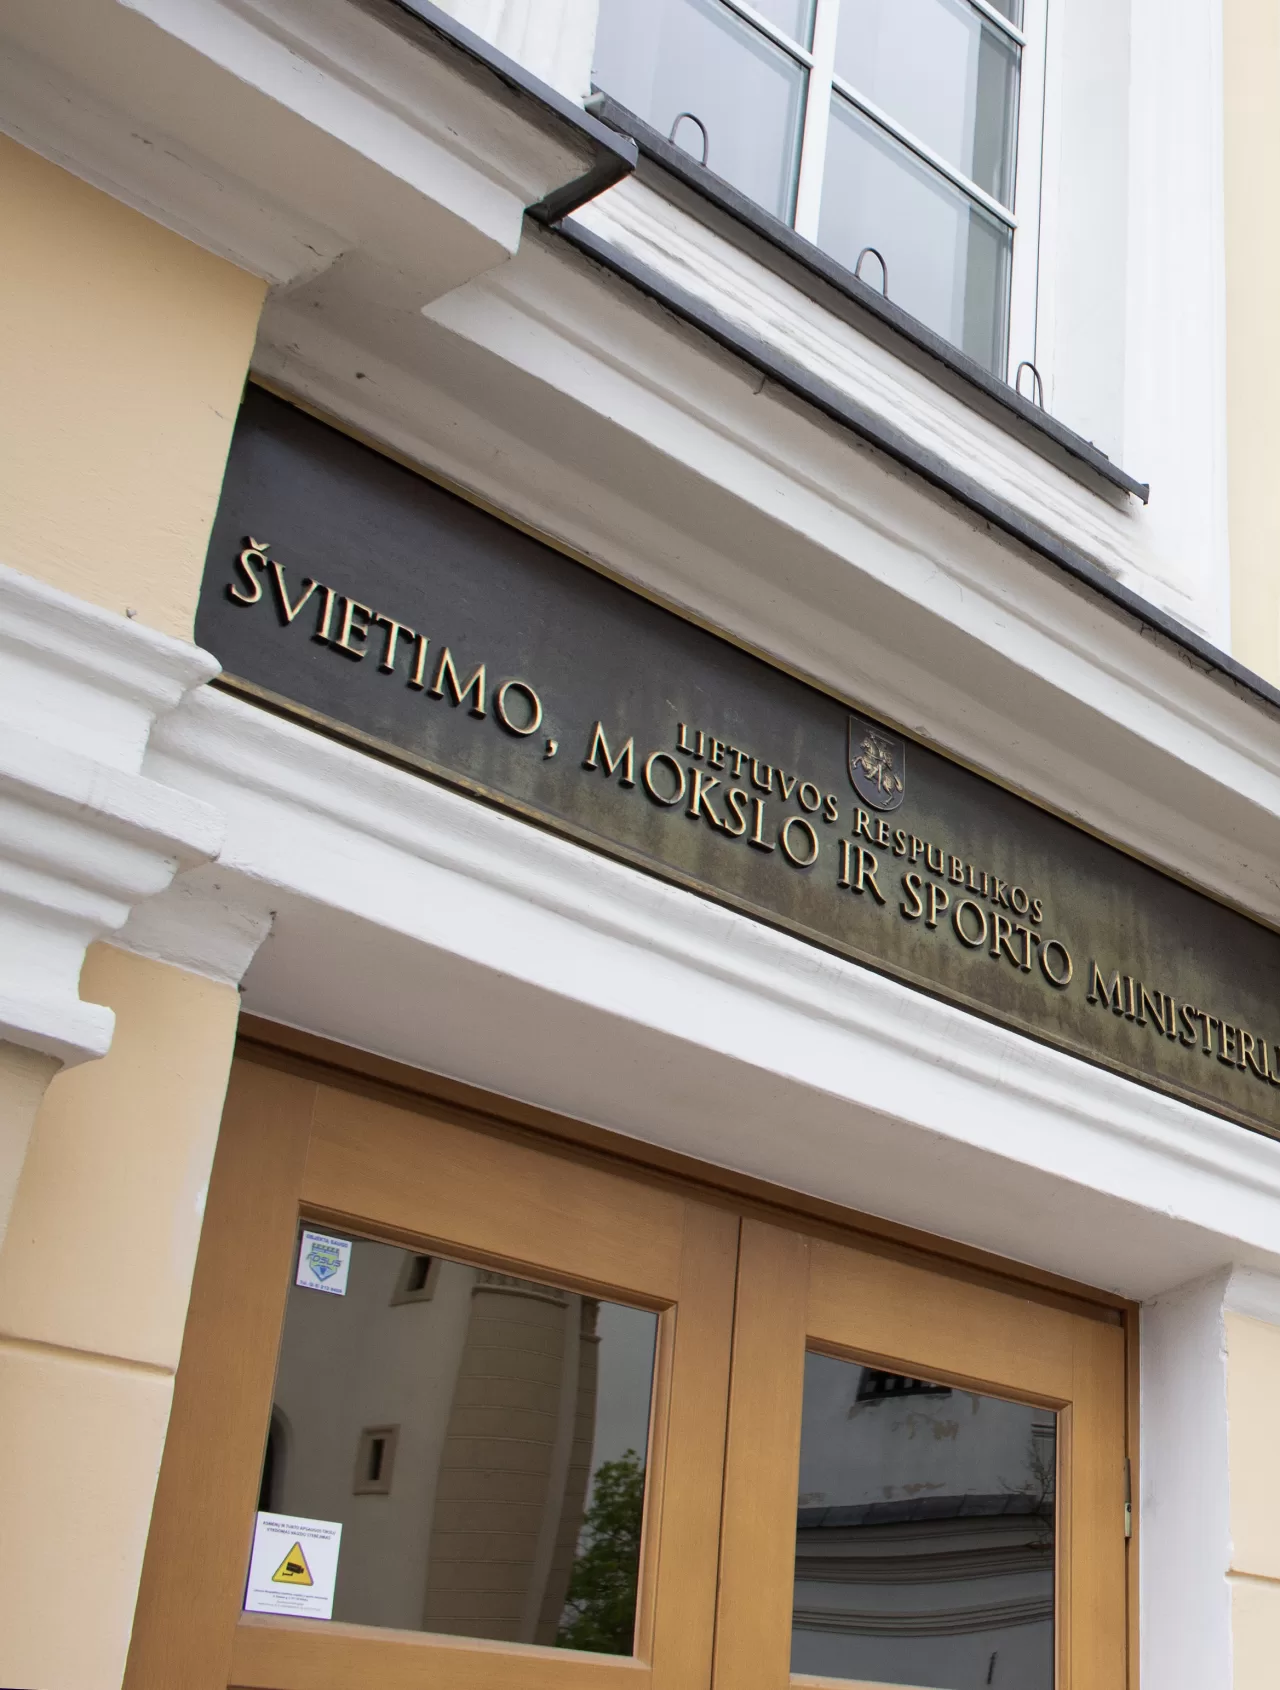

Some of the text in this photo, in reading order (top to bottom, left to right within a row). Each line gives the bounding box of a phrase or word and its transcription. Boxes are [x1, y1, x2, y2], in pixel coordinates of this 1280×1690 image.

[227, 536, 558, 760] ŠVIETIMO,
[584, 721, 820, 867] MOKSLO
[837, 839, 887, 904] IR
[900, 872, 1074, 988] SPORTO
[677, 722, 1044, 924] LIETUVOS RESPUBLIKOS
